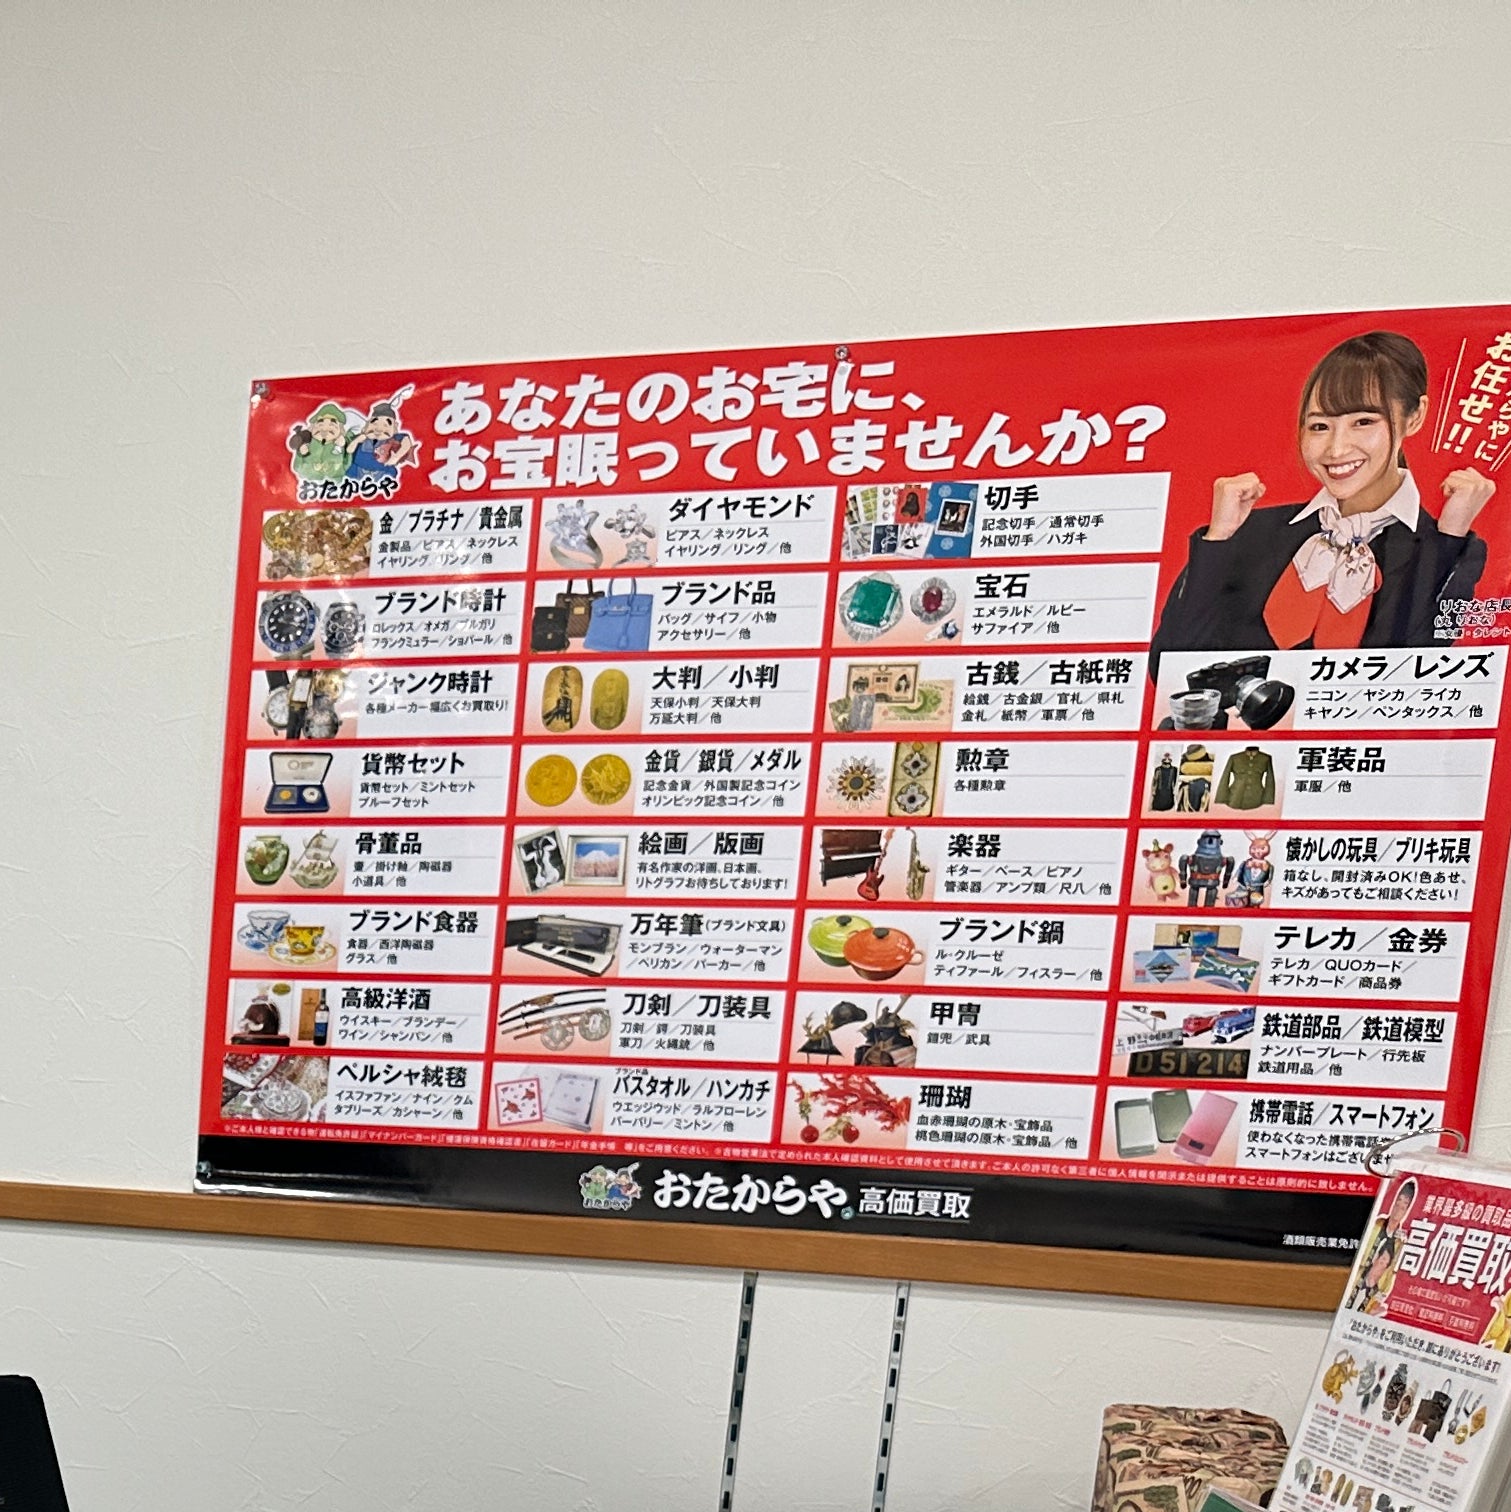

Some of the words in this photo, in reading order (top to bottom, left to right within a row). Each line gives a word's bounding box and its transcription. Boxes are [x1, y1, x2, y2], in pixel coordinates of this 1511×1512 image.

[433, 358, 926, 436] あなたのお宅に、
[429, 402, 1168, 493] お宝眠っていませんか?
[299, 477, 398, 500] おたからや
[984, 484, 1039, 510] 切手
[668, 494, 814, 522] ダイヤモンド
[662, 580, 776, 606] ブランド品
[974, 573, 1030, 599] 宝石
[375, 587, 506, 615] ブランド時計
[652, 664, 779, 690] 大判／小判
[966, 658, 1133, 687] 古銭／古紙幣
[1310, 652, 1494, 681] カメラ／レンズ
[368, 670, 493, 695] ジャンク時計
[362, 752, 465, 776] 貨幣セット
[645, 749, 801, 773] 金貨／銀貨／メダル
[955, 747, 1010, 773] 勲章
[1297, 747, 1386, 773] 軍装品
[953, 779, 1006, 792] 各種勲章
[355, 832, 423, 855] 骨董品
[638, 831, 764, 856] 絵画／版画
[948, 833, 1001, 858] 楽器
[350, 910, 479, 933] ブランド食器
[939, 917, 1065, 945] ブランド鍋
[1274, 925, 1448, 954] テレカ／金券
[340, 986, 431, 1010] 高級洋酒
[622, 993, 771, 1020] 刀剣／刀装具
[930, 1002, 981, 1027] 甲冑
[1261, 1012, 1445, 1043] 鉄道部品／鉄道模型
[337, 1063, 467, 1088] ペルシャ絨毯
[613, 1075, 771, 1102] バスタオル／ハンカチ
[918, 1084, 972, 1109] 珊瑚
[1249, 1099, 1435, 1130] 携帯電話／スマートフォン
[653, 1168, 848, 1219] おたからや
[858, 1187, 972, 1219] 高価買取
[1394, 1218, 1511, 1295] 高価買取
